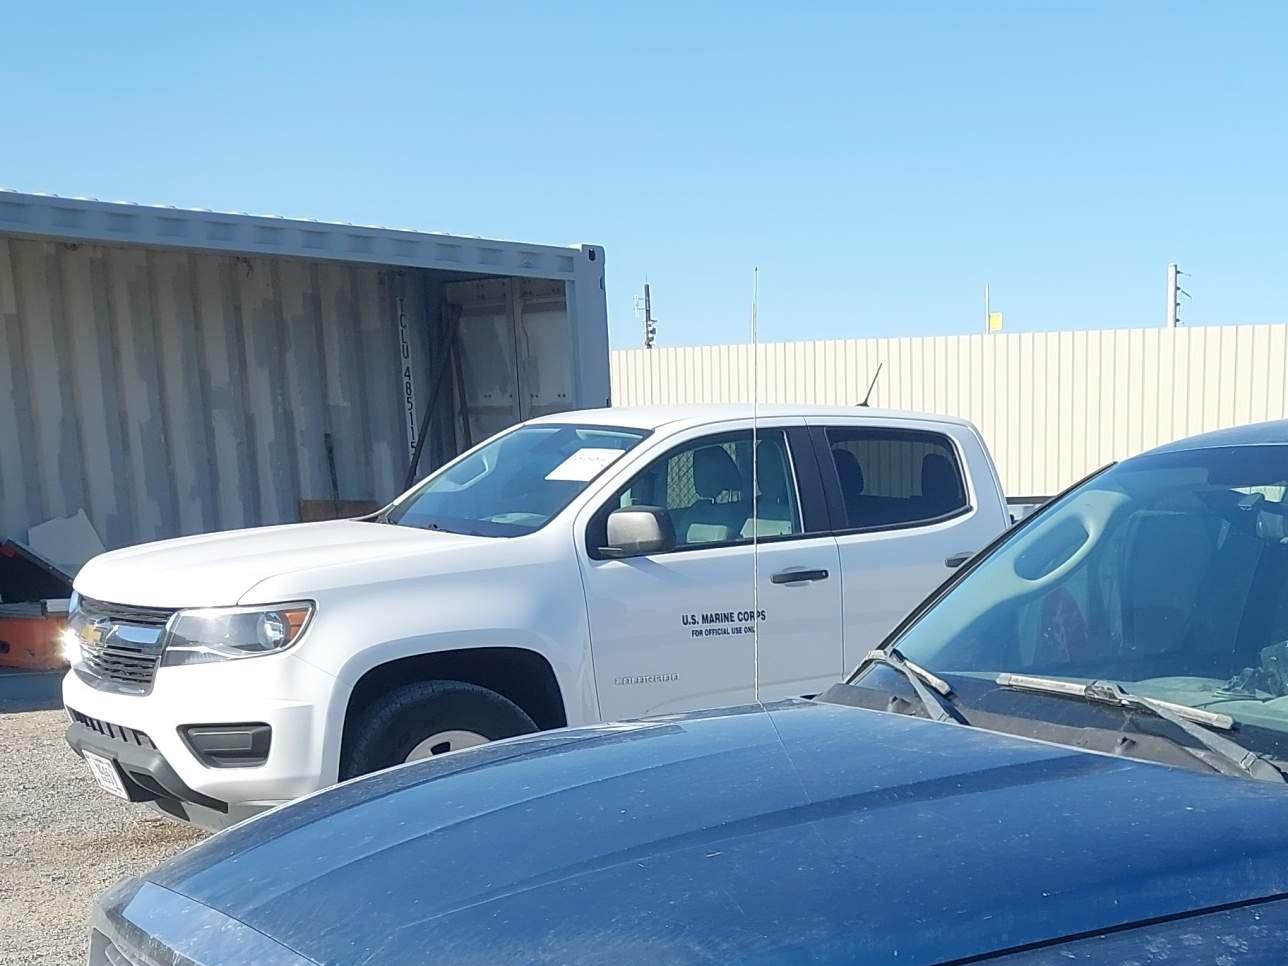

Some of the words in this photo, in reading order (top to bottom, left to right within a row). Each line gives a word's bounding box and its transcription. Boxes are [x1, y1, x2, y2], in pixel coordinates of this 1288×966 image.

[682, 614, 700, 625] U.S.
[701, 612, 735, 624] MARINE
[737, 610, 766, 622] CORPS
[691, 629, 703, 637] FOR
[704, 627, 730, 636] OFFICIAL
